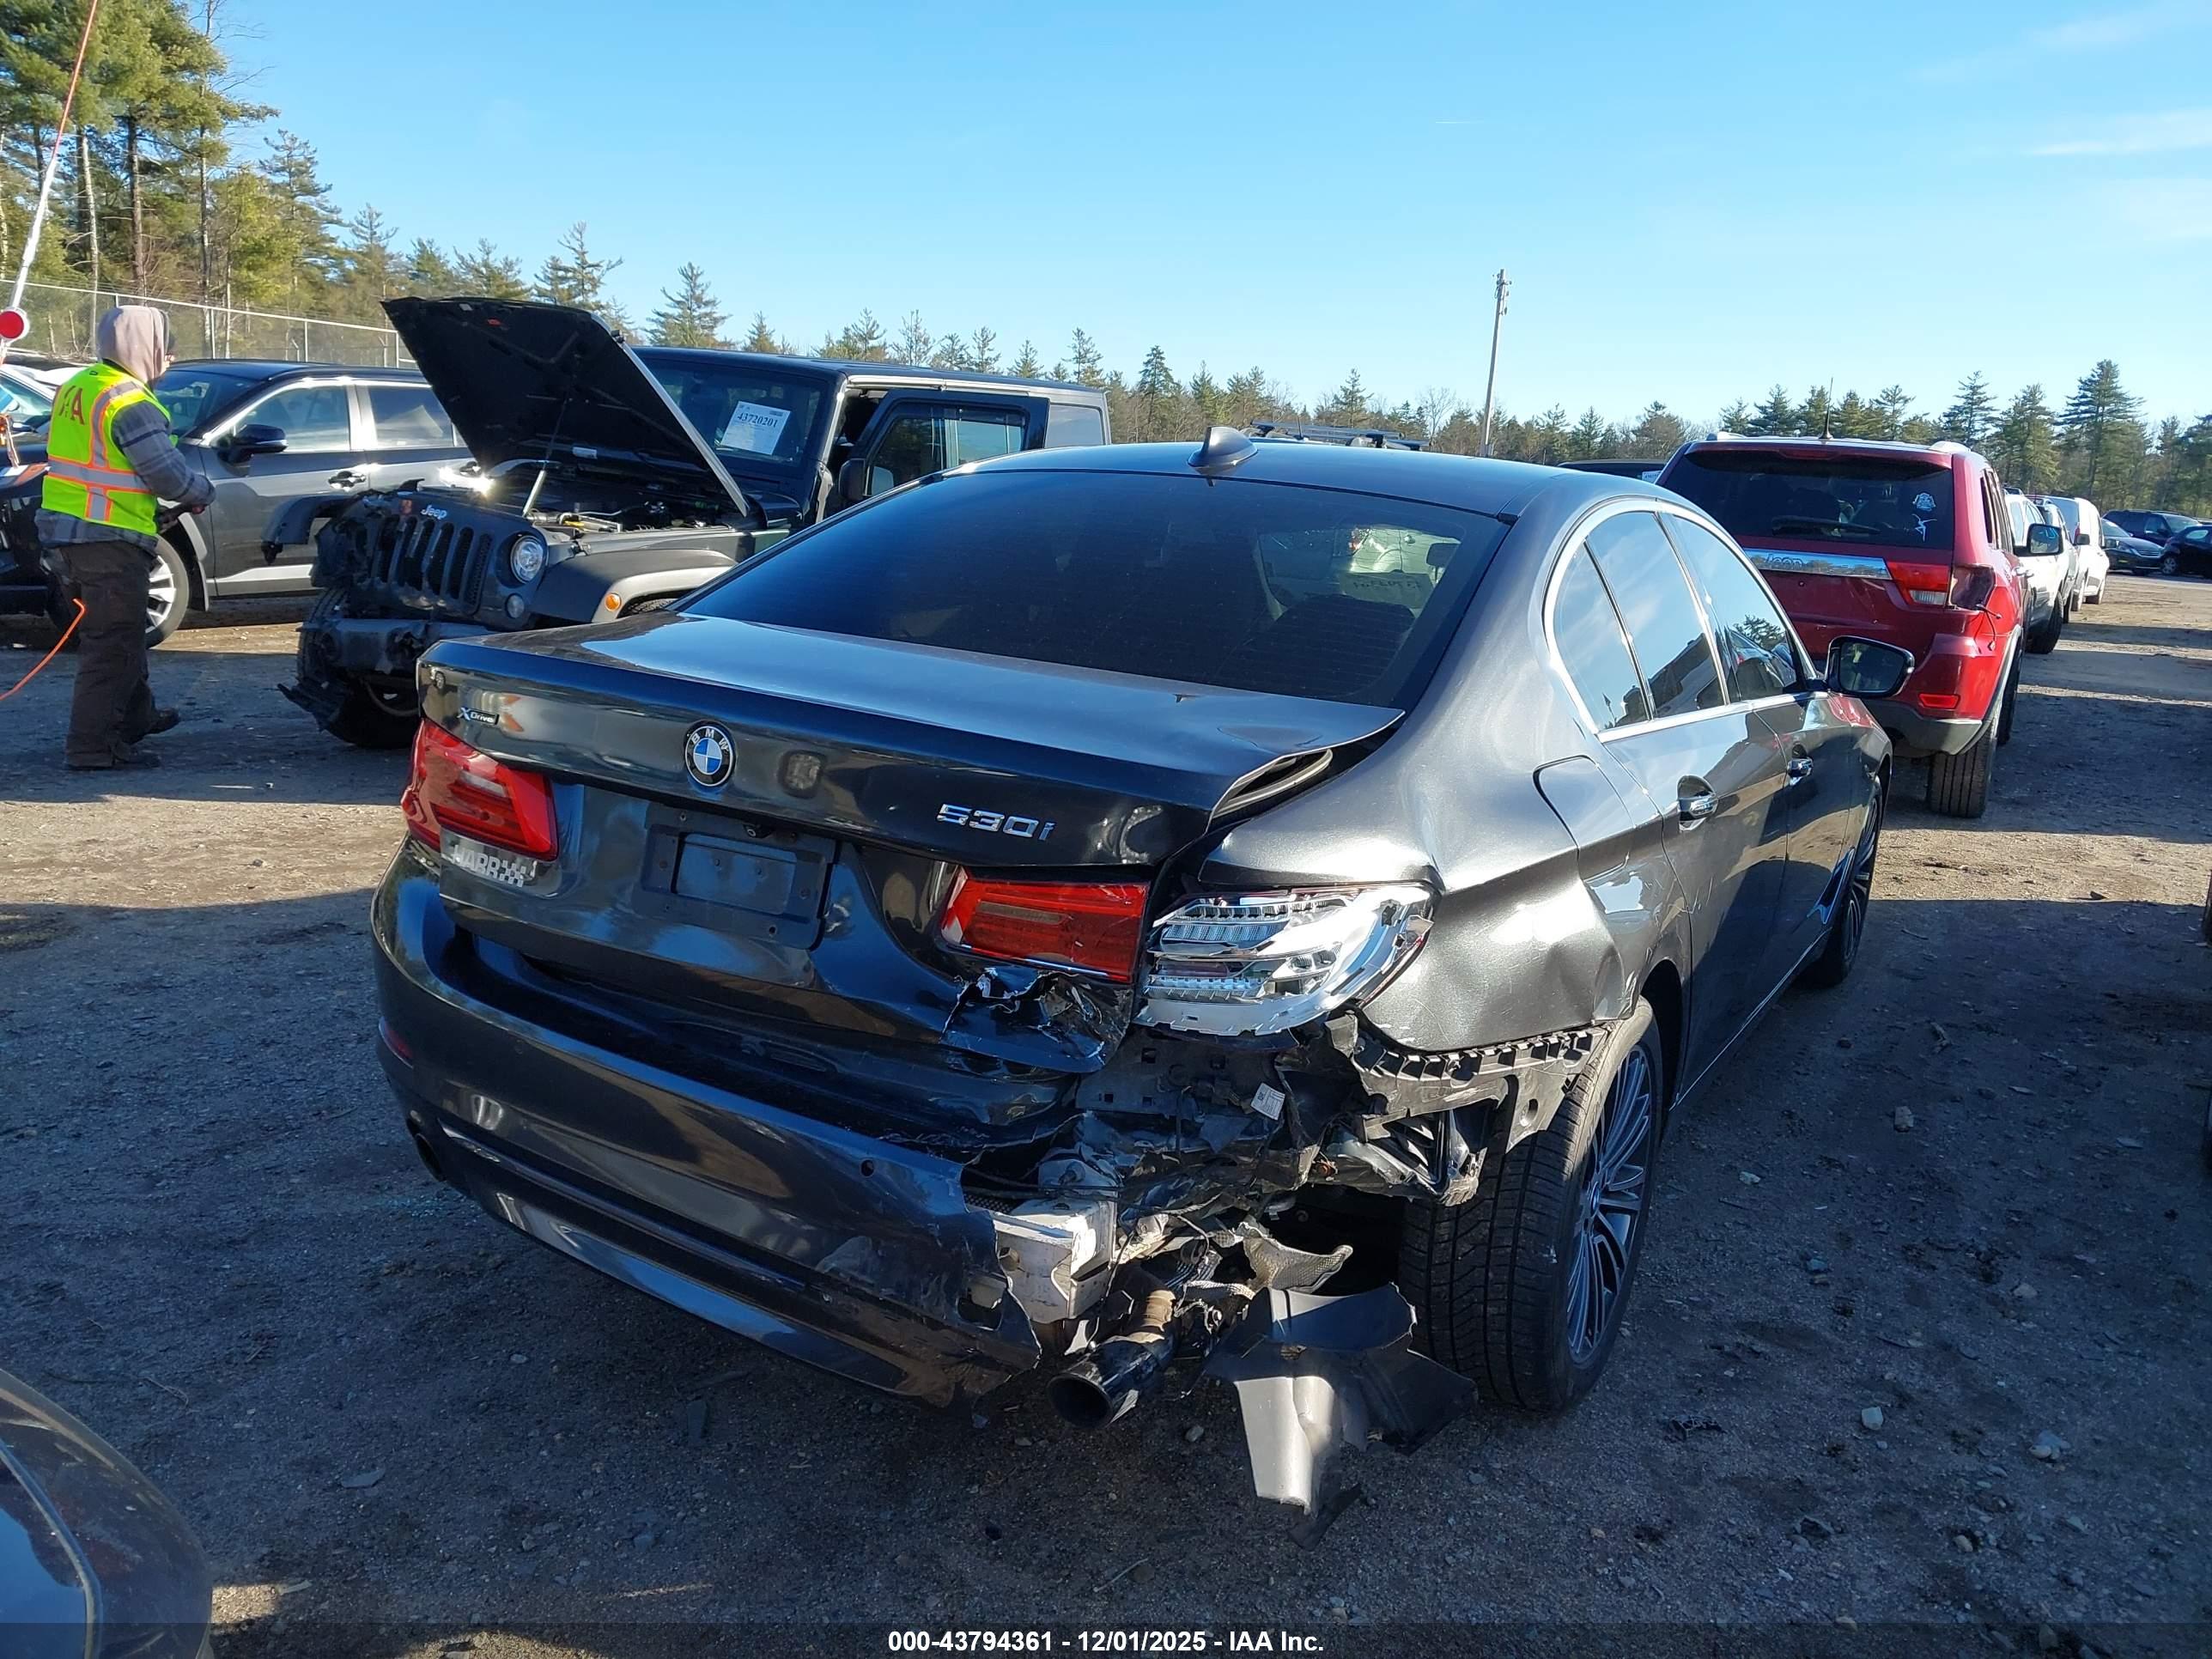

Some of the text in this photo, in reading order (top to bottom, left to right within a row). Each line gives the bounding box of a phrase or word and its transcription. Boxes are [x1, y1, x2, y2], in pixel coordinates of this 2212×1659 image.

[737, 412, 778, 428] 43720201
[420, 503, 447, 520] Jeep
[1765, 553, 1803, 568] Jeep
[936, 803, 1056, 841] 530i
